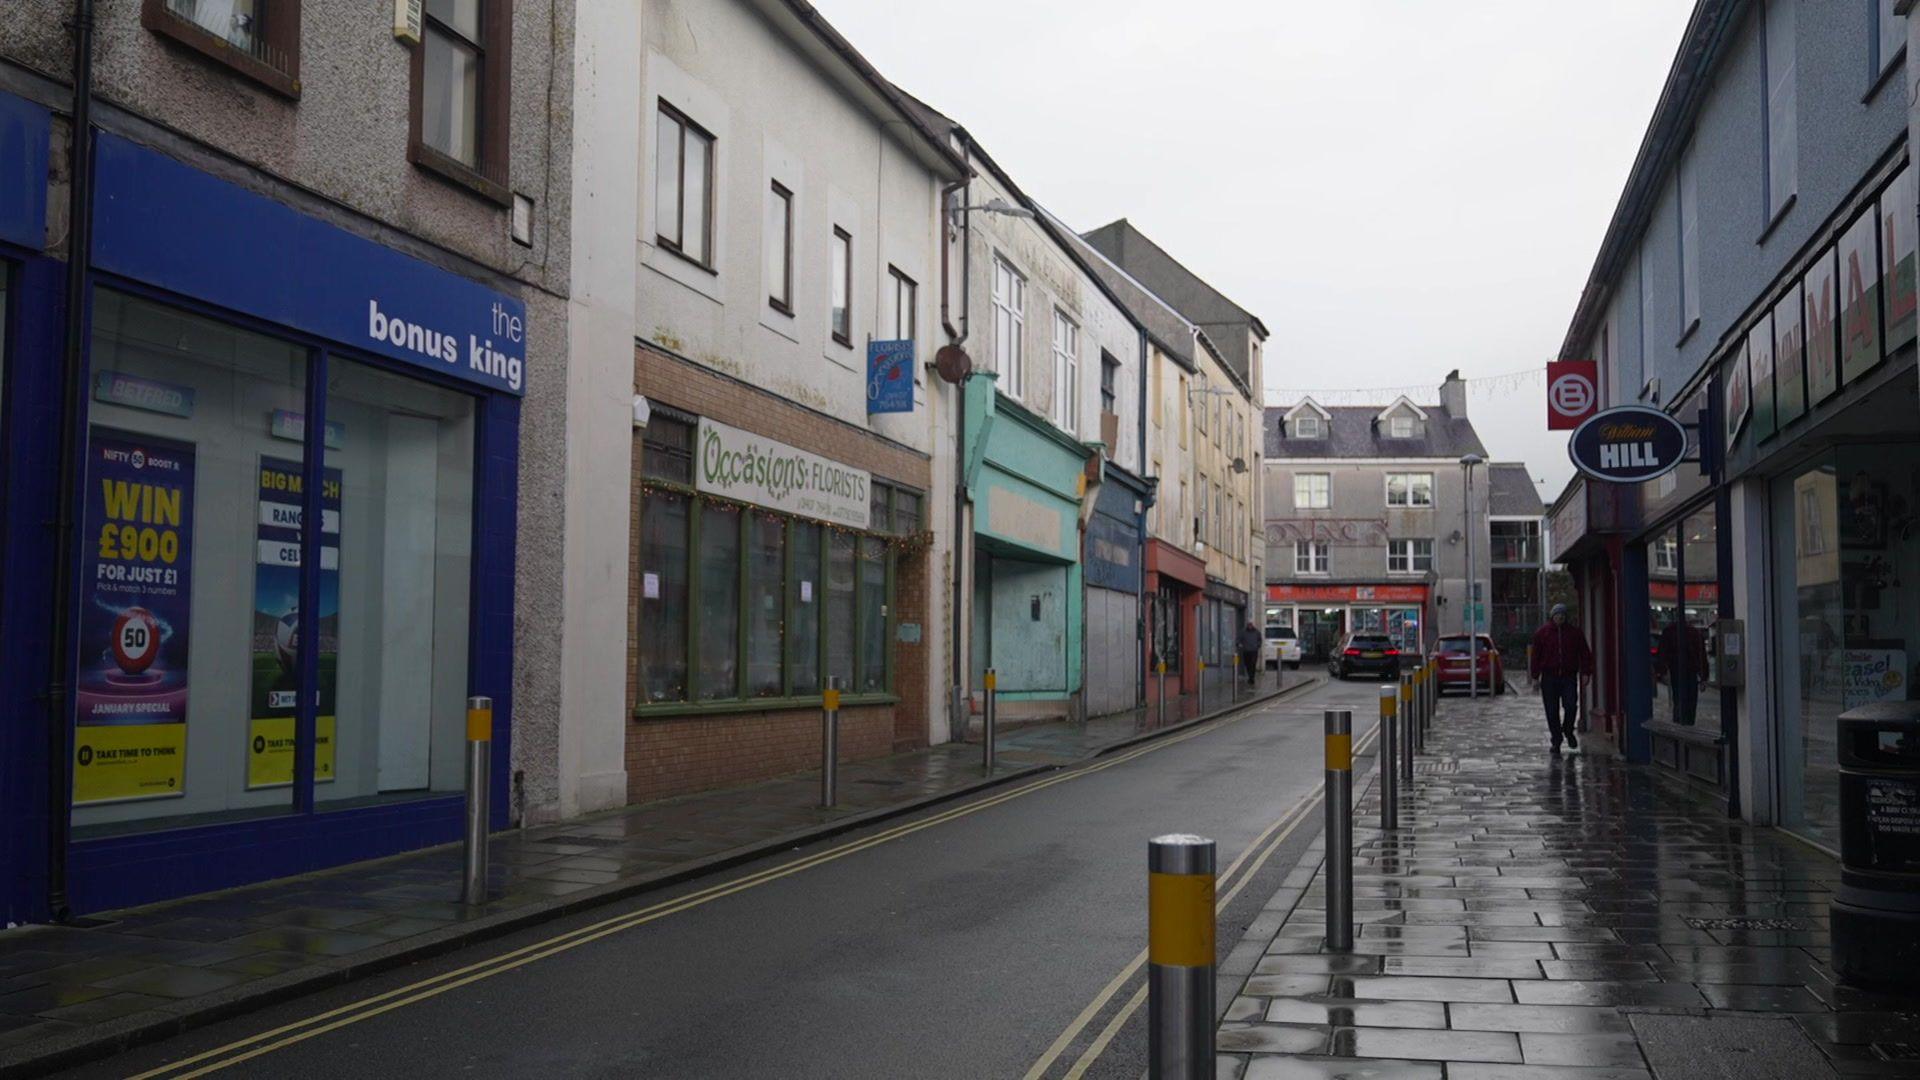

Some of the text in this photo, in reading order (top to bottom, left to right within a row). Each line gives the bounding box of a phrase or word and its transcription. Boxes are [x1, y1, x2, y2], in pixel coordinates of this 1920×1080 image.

[492, 302, 522, 342] the
[369, 299, 522, 390] bonus king
[1602, 424, 1656, 440] William
[103, 449, 129, 462] NIFTY
[1600, 441, 1659, 469] HILL
[262, 470, 340, 498] BIG MCH
[812, 462, 865, 501] FLORISTS
[102, 478, 181, 527] WIN
[99, 522, 179, 564] £900
[280, 548, 301, 562] CEL
[97, 563, 177, 585] FOR JUST £1
[124, 628, 146, 648] 50
[91, 703, 171, 714] JANUARY SPECIAL
[96, 746, 176, 759] TAKE TIME TO THINK
